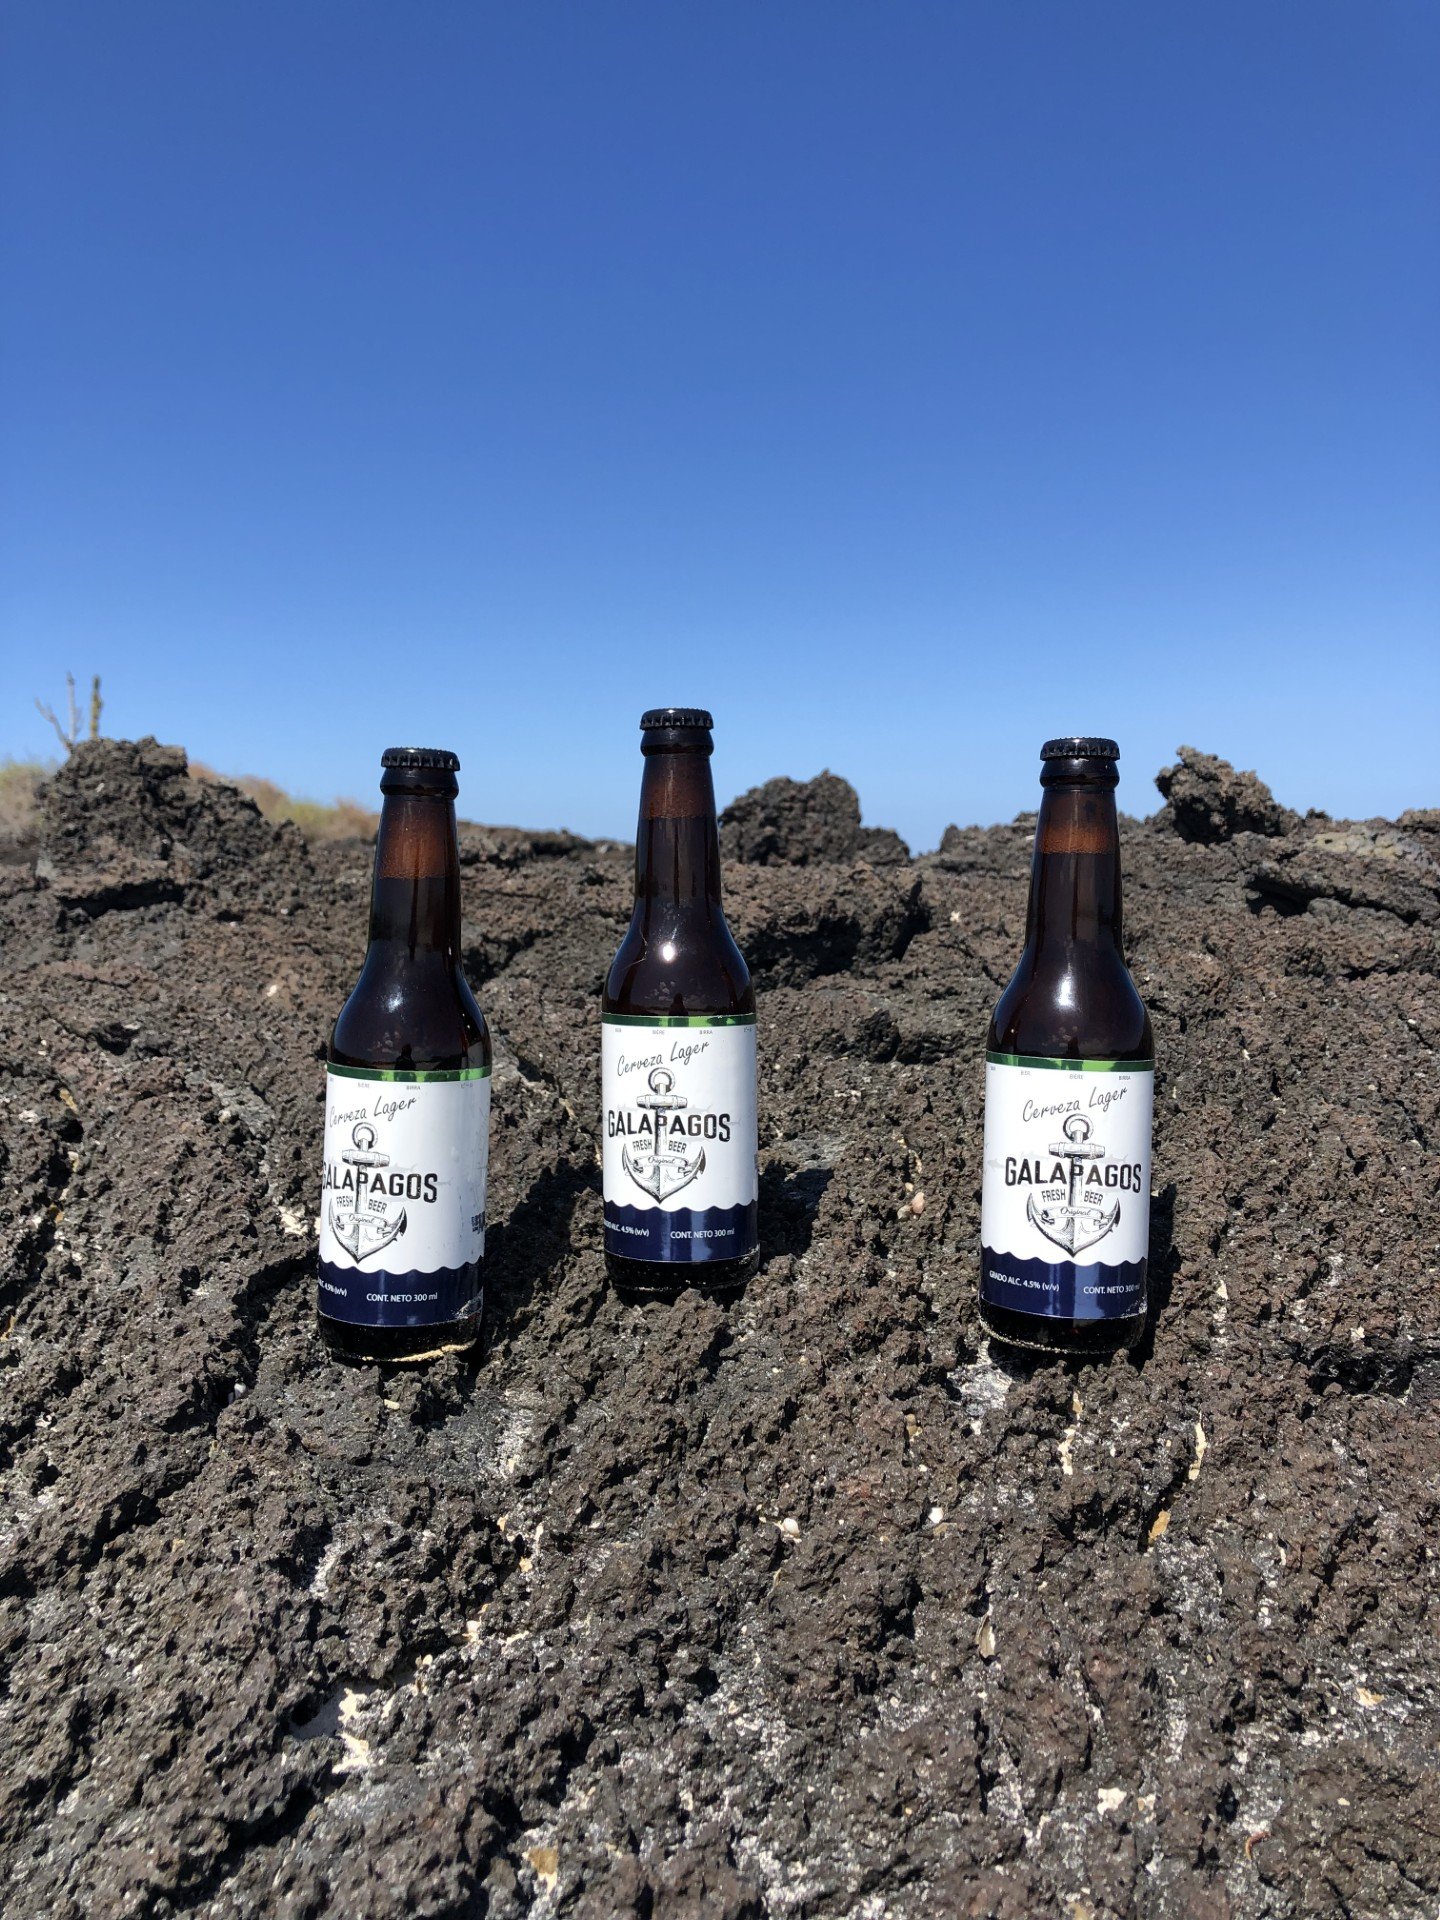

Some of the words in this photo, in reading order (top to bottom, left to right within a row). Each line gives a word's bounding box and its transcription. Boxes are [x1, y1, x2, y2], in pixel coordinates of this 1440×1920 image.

[617, 1054, 664, 1077] Cerveza
[670, 1041, 710, 1066] Lager
[329, 1105, 368, 1128] Cerveza
[373, 1095, 417, 1122] Lager
[1022, 1100, 1080, 1122] Cerveza
[1088, 1086, 1128, 1112] Lager
[608, 1109, 731, 1143] GALAPAGOS
[632, 1139, 653, 1152] FRESH
[668, 1140, 687, 1154] BEER
[648, 1155, 676, 1165] Original
[1005, 1156, 1142, 1194] GALAPAGOS
[336, 1196, 354, 1208] FRESH
[368, 1199, 388, 1214] BEER
[1041, 1189, 1066, 1203] FRESH
[1084, 1190, 1104, 1206] BEER
[348, 1213, 376, 1224] Original
[1060, 1206, 1092, 1217] Original
[670, 1230, 692, 1239] CONT.
[693, 1230, 713, 1239] NETO
[714, 1229, 727, 1238] 300
[1007, 1276, 1022, 1286] ALC.
[1022, 1279, 1041, 1289] 4.5%
[1042, 1282, 1060, 1292] (v/v)
[1083, 1286, 1106, 1294] CONT.
[1106, 1285, 1125, 1294] NETO
[366, 1293, 389, 1302] CONT.
[390, 1294, 413, 1303] NETO
[413, 1293, 428, 1302] 300
[428, 1291, 438, 1301] ml
